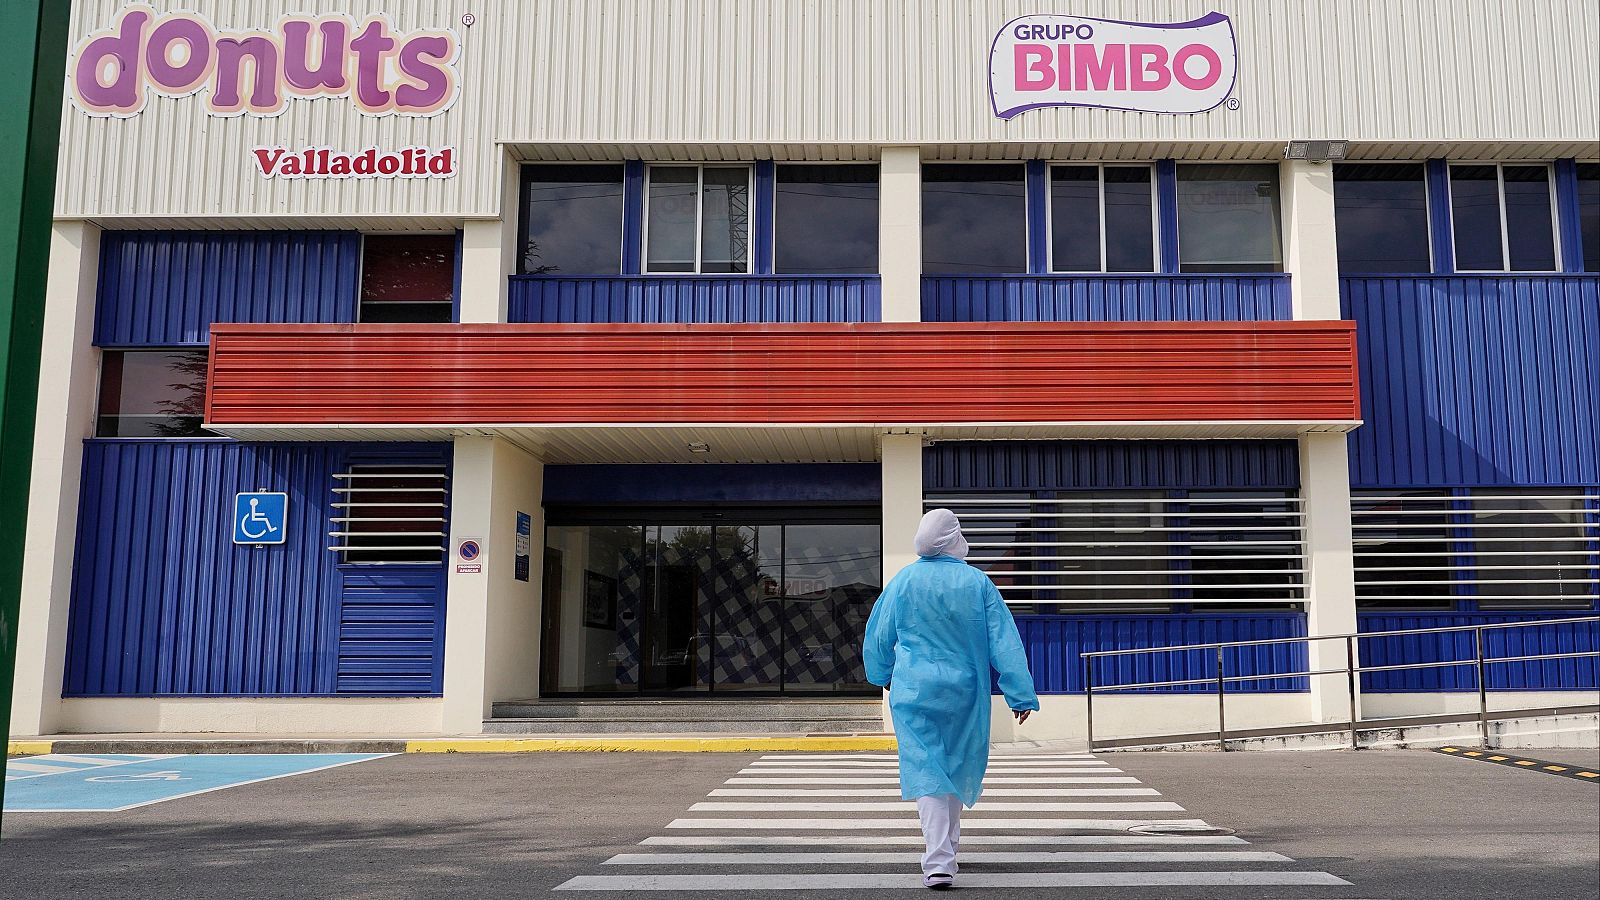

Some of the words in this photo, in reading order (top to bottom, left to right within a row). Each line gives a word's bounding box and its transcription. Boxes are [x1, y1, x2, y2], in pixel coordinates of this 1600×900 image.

[1014, 24, 1094, 40] GRUPO
[76, 10, 449, 107] donuts
[1014, 43, 1222, 91] BIMBO
[254, 149, 452, 176] Valladolid
[764, 580, 827, 595] BMBO
